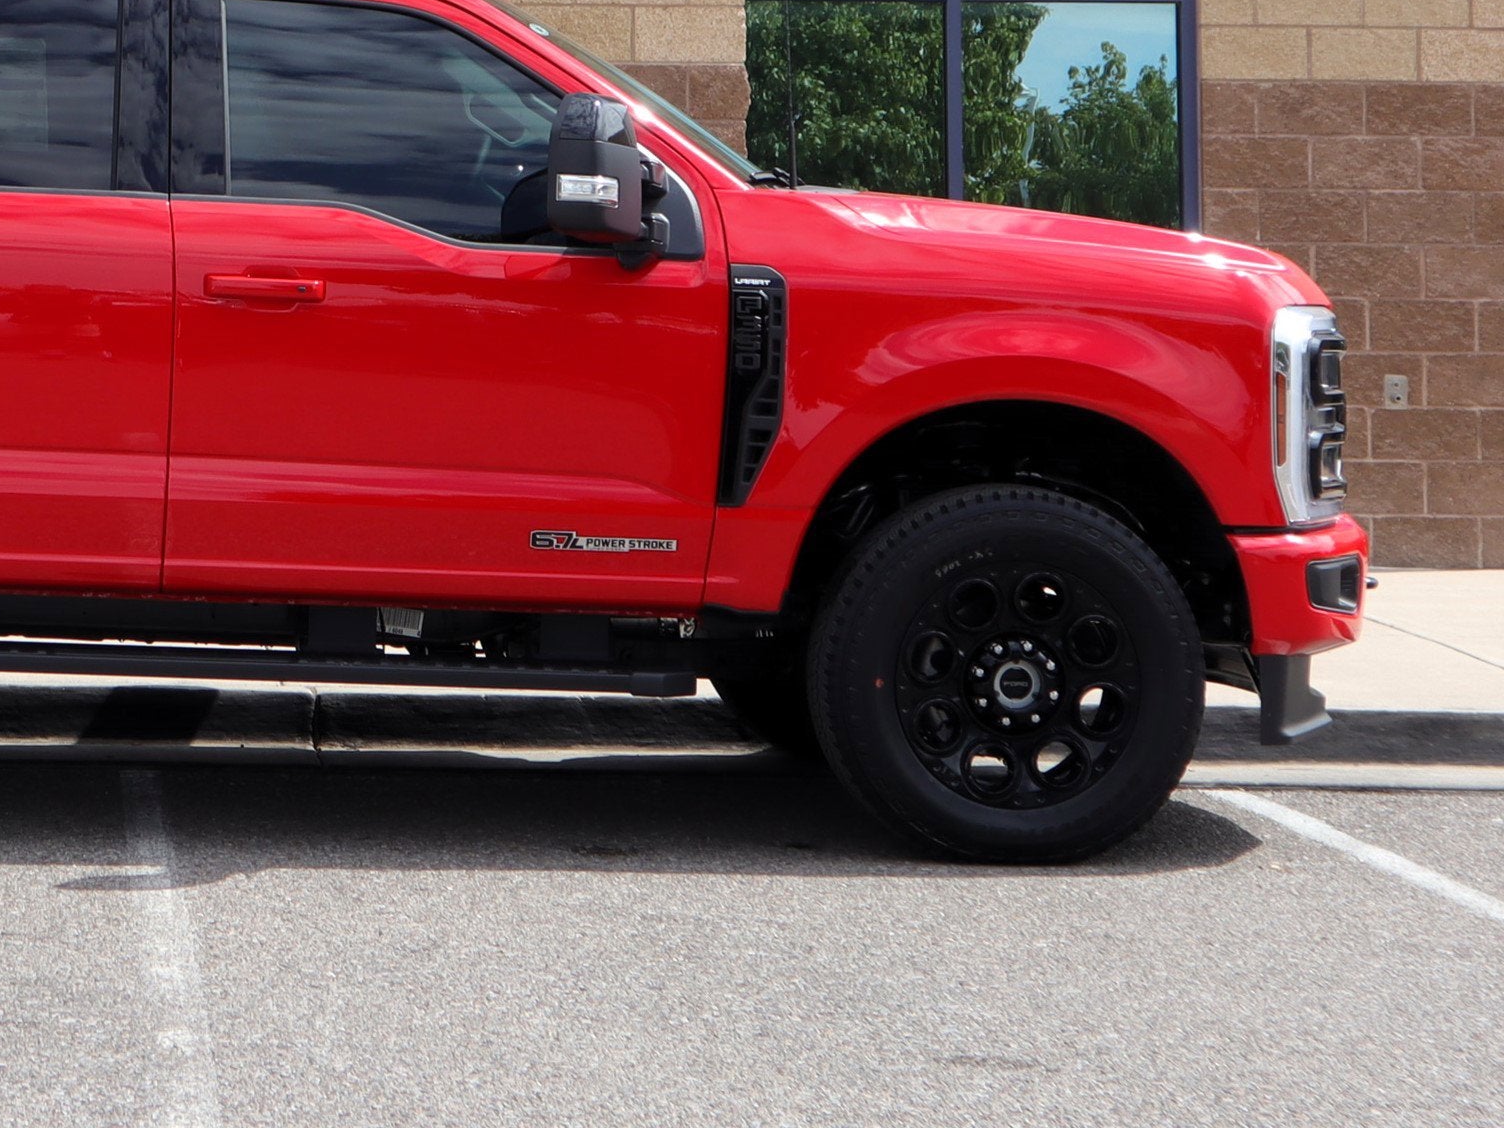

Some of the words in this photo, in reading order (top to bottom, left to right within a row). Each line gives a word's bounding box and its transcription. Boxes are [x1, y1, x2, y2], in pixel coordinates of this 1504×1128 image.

[530, 530, 584, 550] 6.7L
[586, 538, 626, 549] POWER
[628, 540, 674, 550] STROKE
